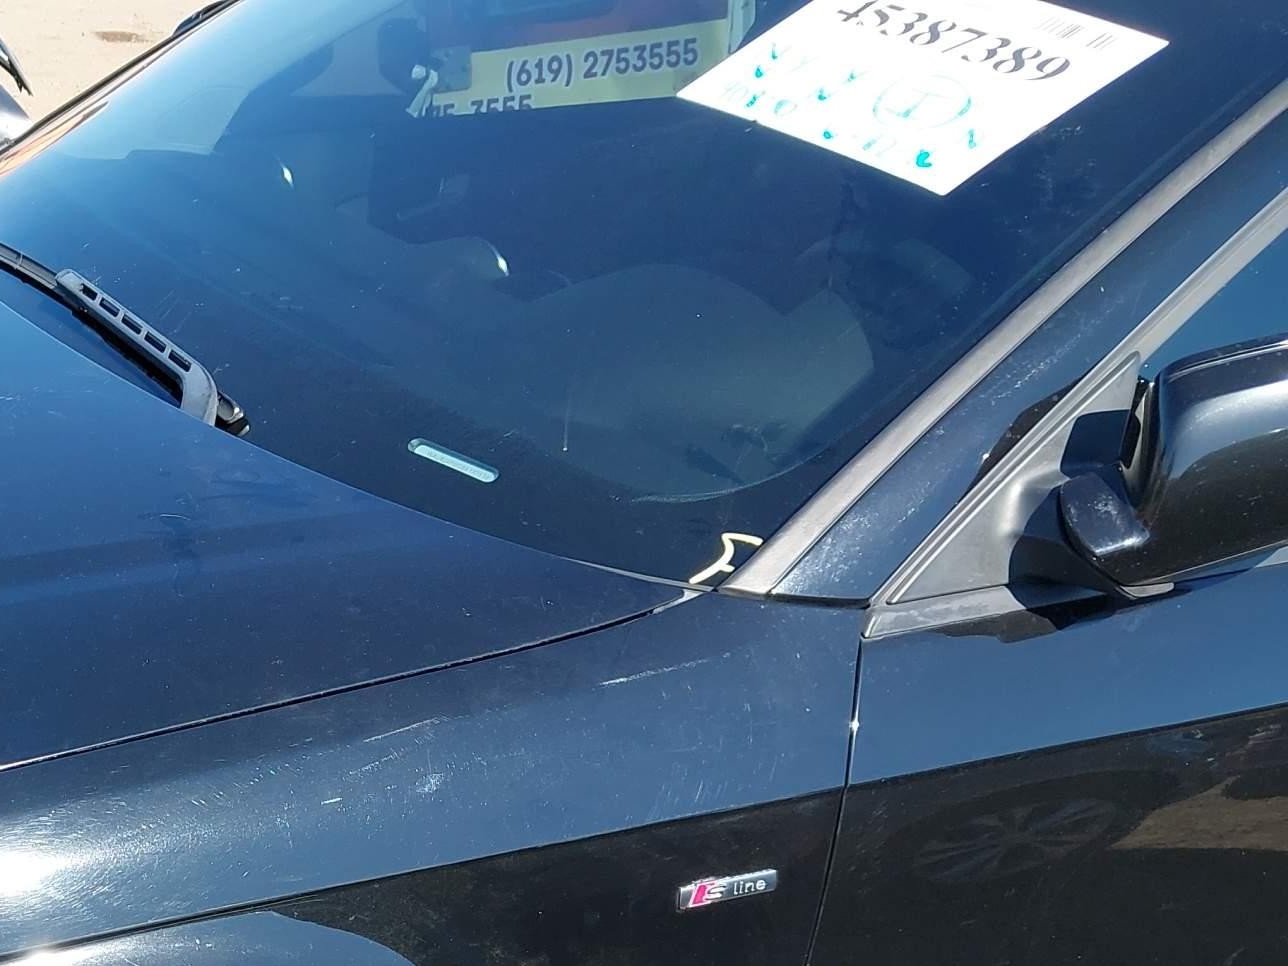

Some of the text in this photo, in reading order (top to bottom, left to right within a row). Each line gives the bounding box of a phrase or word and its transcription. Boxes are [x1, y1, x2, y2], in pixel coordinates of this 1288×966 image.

[506, 54, 573, 92] (619)
[582, 38, 698, 79] 2753555
[835, 0, 1071, 81] 45387389
[733, 879, 767, 895] line
